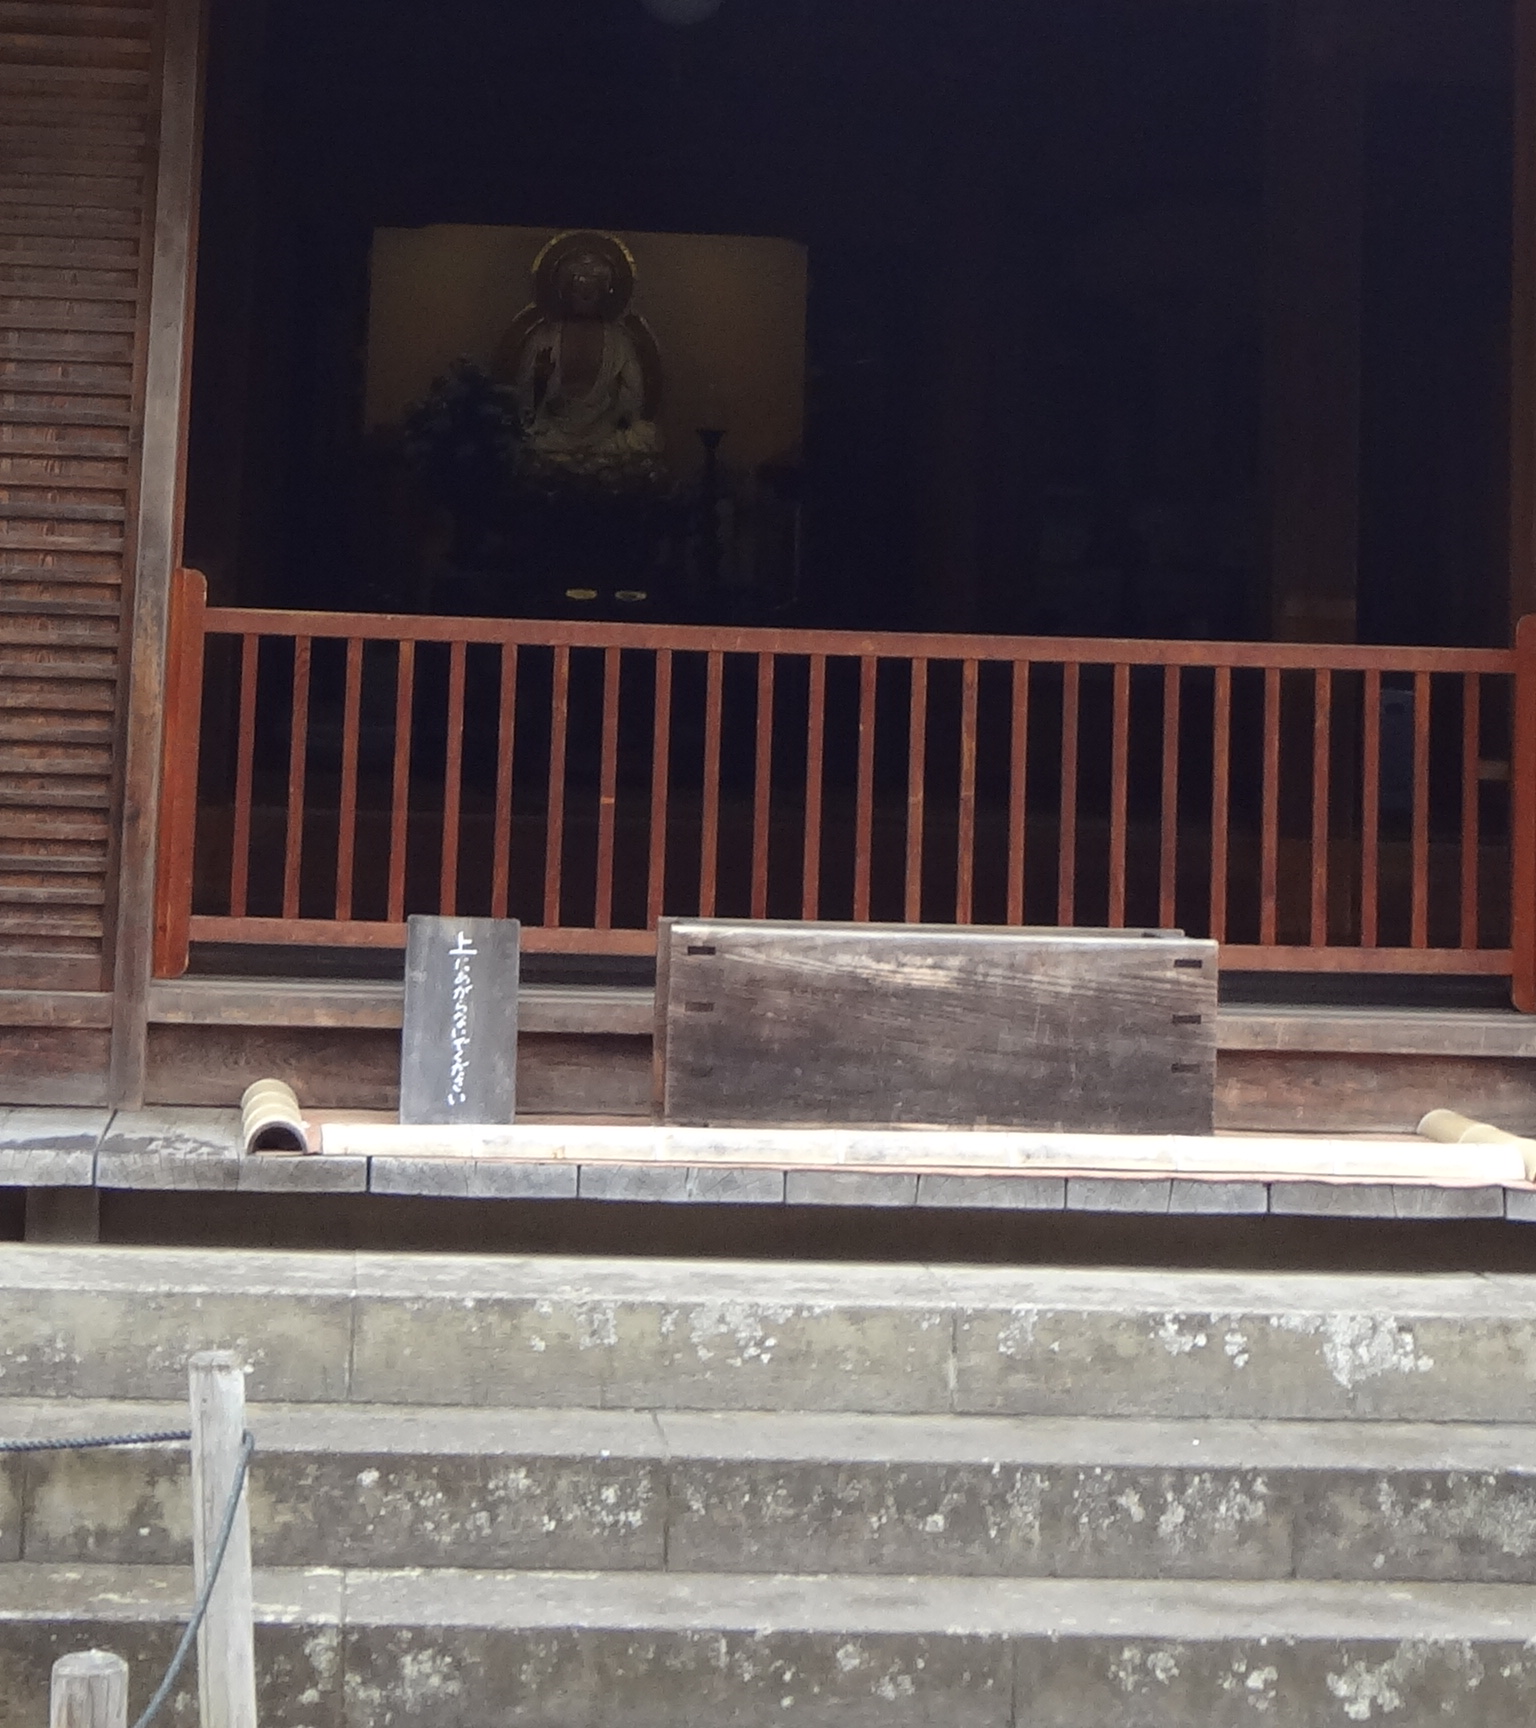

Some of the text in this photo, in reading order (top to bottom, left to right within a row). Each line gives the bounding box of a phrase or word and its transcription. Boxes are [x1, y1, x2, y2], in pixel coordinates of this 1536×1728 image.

[448, 930, 478, 1105] 上にあがらないでください
